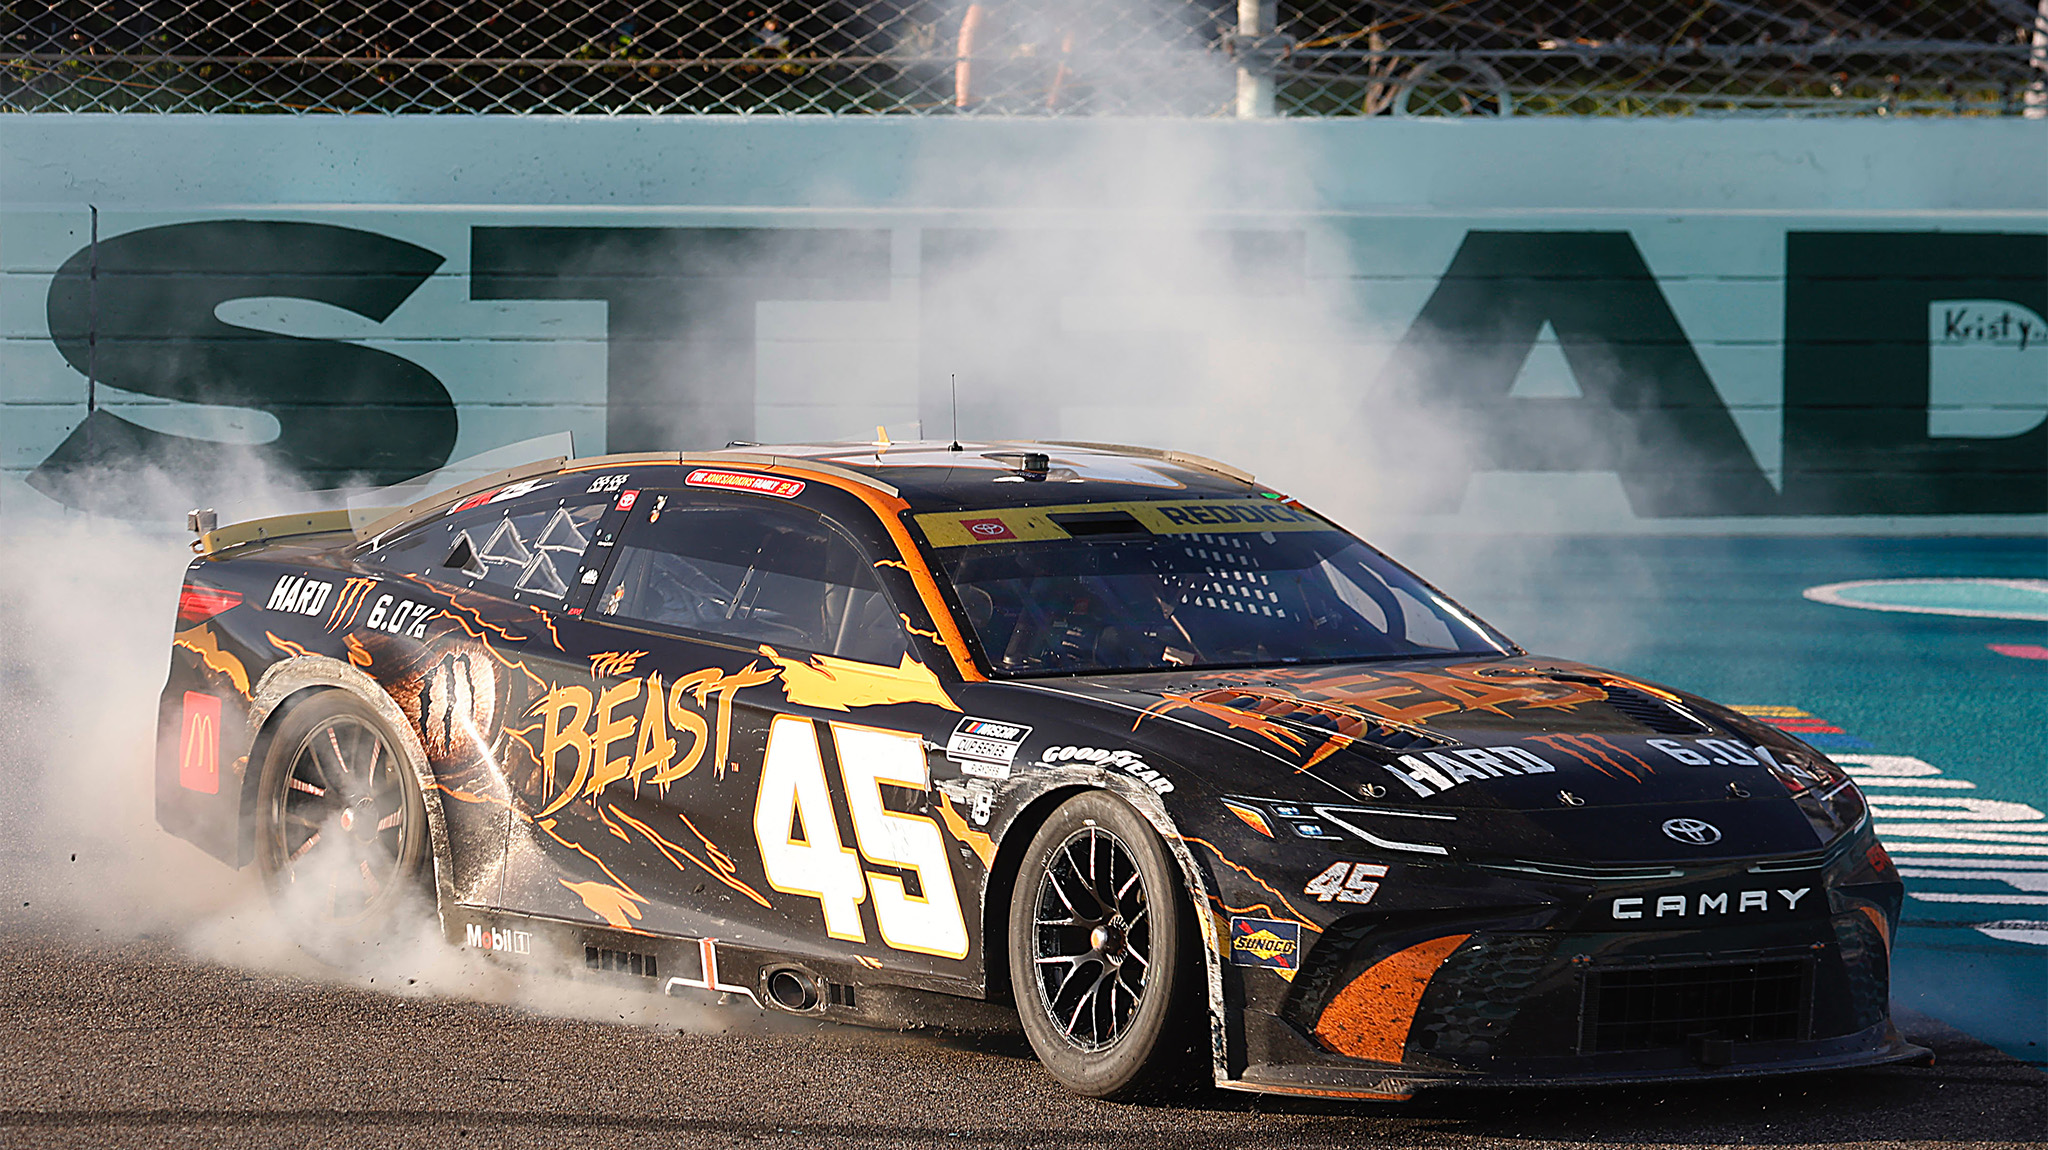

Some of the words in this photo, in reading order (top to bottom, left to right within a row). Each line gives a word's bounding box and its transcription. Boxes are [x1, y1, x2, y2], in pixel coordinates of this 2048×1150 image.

[1156, 505, 1318, 525] REDDICK
[266, 574, 333, 617] HARD
[366, 593, 436, 639] 6.0%
[589, 650, 650, 679] THE
[522, 659, 783, 819] BEAST
[976, 722, 1020, 740] NASCAR
[957, 739, 978, 752] CUP
[976, 742, 1008, 757] SERIES
[1042, 746, 1175, 796] GOODYEAR
[1383, 746, 1556, 798] HARD
[753, 713, 970, 960] 45
[1304, 861, 1390, 904] 45
[1612, 887, 1811, 919] CAMRY
[466, 922, 512, 953] Mobil
[1237, 937, 1295, 953] SUNOCO
